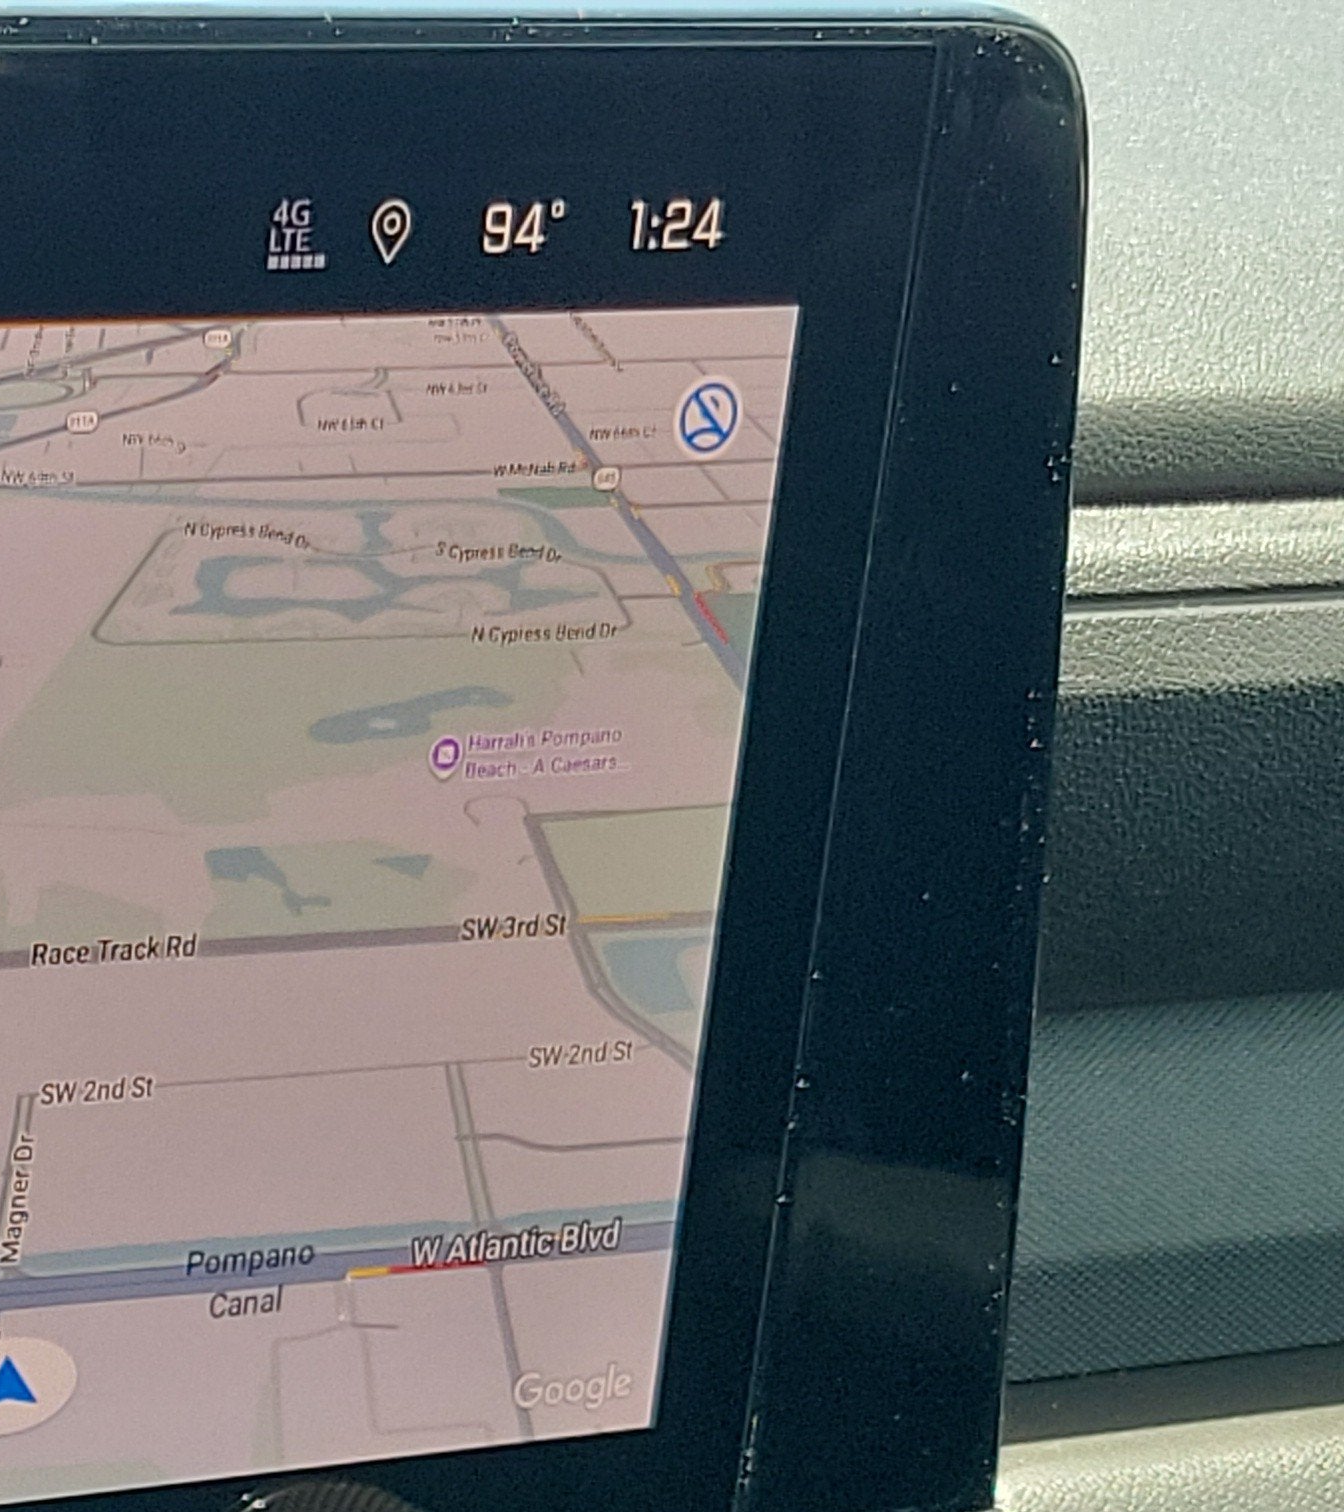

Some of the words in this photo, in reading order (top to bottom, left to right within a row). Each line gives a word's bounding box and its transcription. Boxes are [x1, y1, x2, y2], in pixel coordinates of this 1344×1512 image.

[272, 198, 310, 227] 4G
[482, 198, 565, 254] 94°
[631, 197, 725, 250] 1:24
[269, 227, 312, 253] LTE
[472, 626, 484, 642] N
[489, 626, 551, 647] Cypress
[600, 623, 617, 638] Dr
[541, 728, 623, 747] Pompano
[465, 761, 517, 779] Beach
[533, 759, 544, 774] A
[462, 918, 497, 941] SW
[503, 916, 538, 937] 3rd
[545, 914, 565, 936] St
[31, 944, 90, 966] Race
[98, 936, 159, 962] Track
[166, 933, 197, 957] Rd
[529, 1046, 564, 1067] SW
[568, 1043, 606, 1065] 2nd
[612, 1041, 633, 1062] St
[41, 1082, 76, 1105] SW
[84, 1077, 125, 1101] 2nd
[132, 1076, 153, 1098] St
[14, 1135, 33, 1162] Dr
[0, 1171, 29, 1264] Magner
[412, 1237, 442, 1265] W
[445, 1231, 554, 1264] Atlantic
[558, 1216, 622, 1252] Blvd
[186, 1244, 315, 1277] Pompano
[209, 1285, 283, 1318] Canal
[513, 1364, 632, 1409] Google
